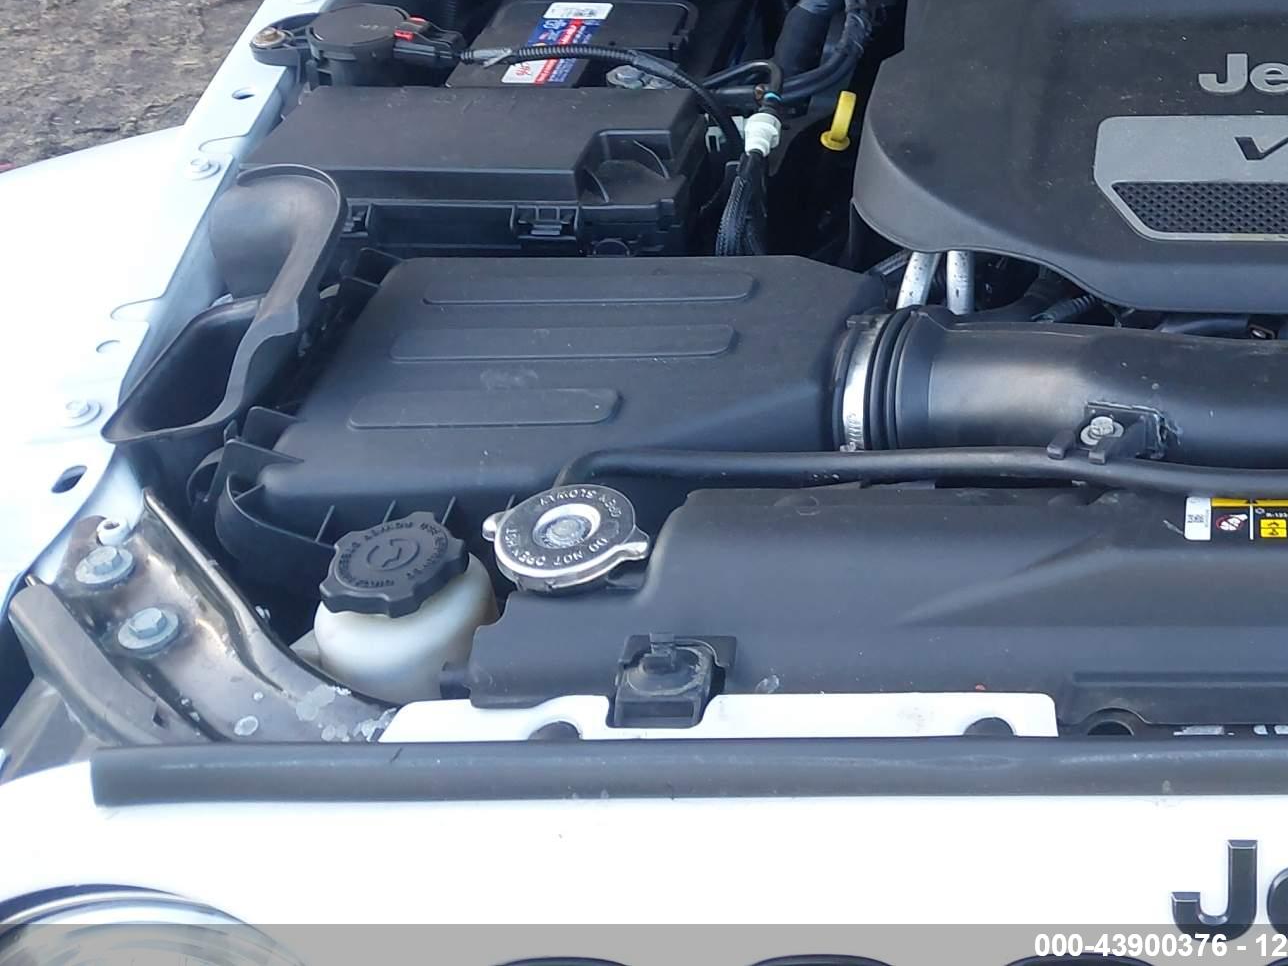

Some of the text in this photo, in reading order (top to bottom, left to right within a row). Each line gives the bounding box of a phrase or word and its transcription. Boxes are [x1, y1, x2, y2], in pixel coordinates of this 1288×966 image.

[588, 537, 608, 552] DO
[512, 548, 546, 566] OPEN
[554, 550, 583, 566] NOT
